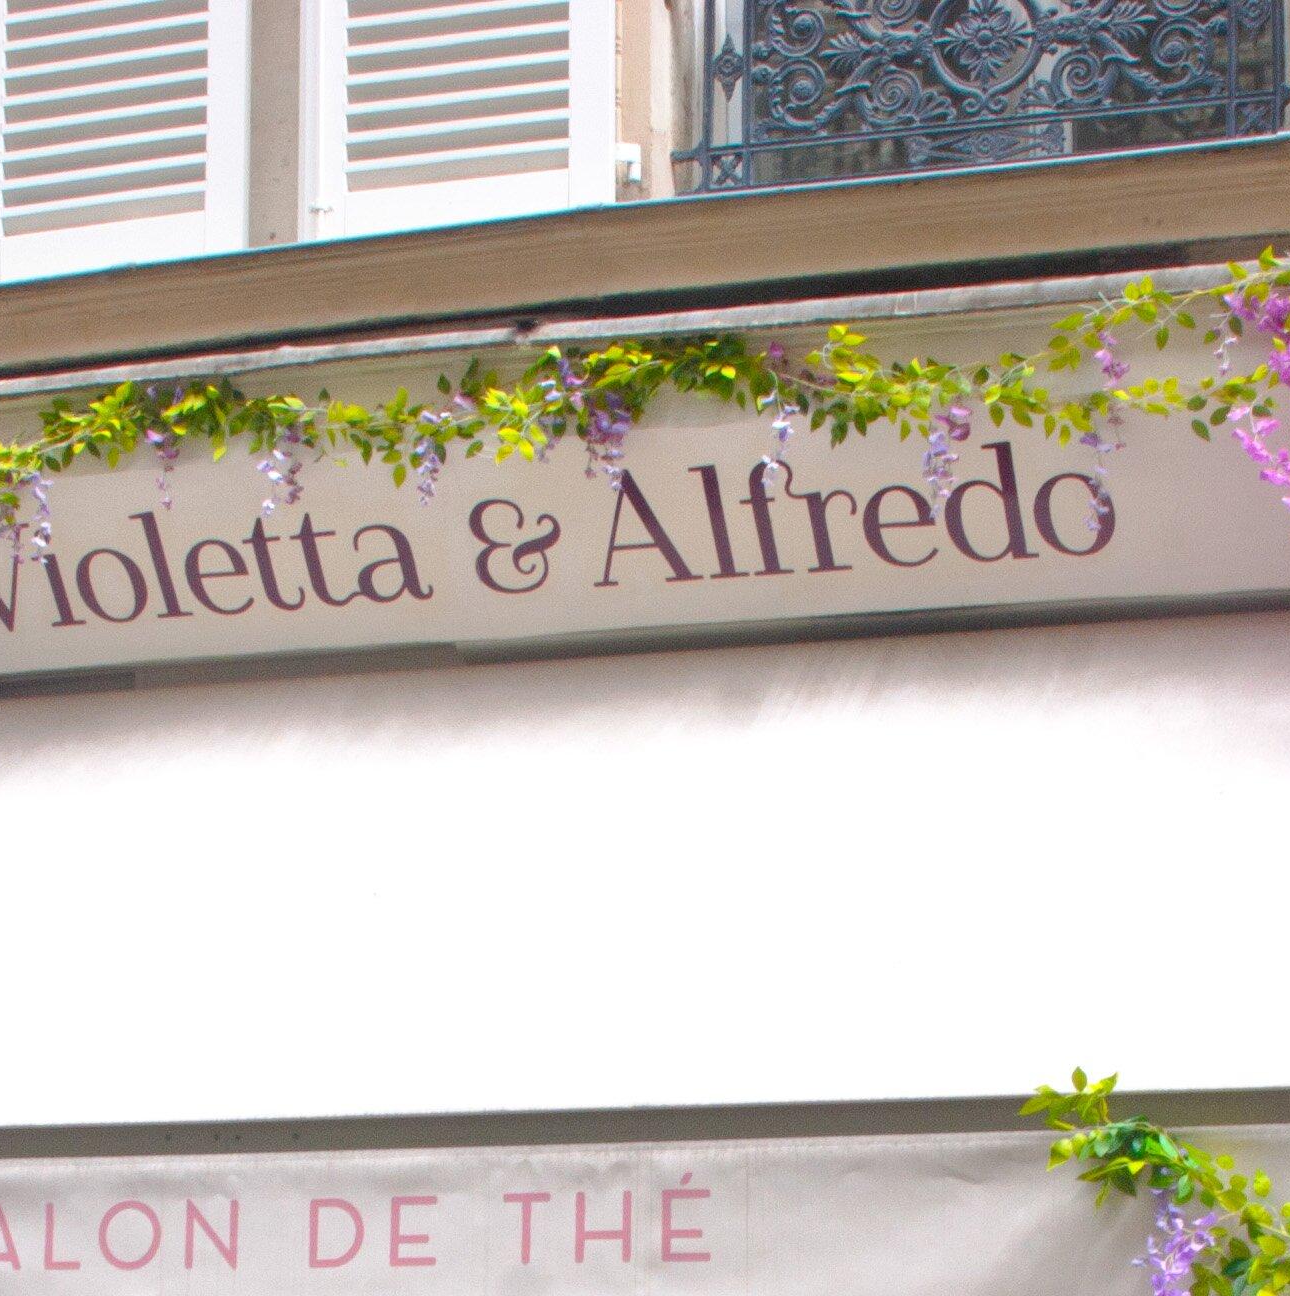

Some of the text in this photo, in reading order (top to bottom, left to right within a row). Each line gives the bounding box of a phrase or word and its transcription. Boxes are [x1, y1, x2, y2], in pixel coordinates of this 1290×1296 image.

[468, 499, 562, 594] &
[593, 441, 1117, 587] Alfredo
[308, 1195, 438, 1269] DE
[502, 1172, 711, 1265] THÉ
